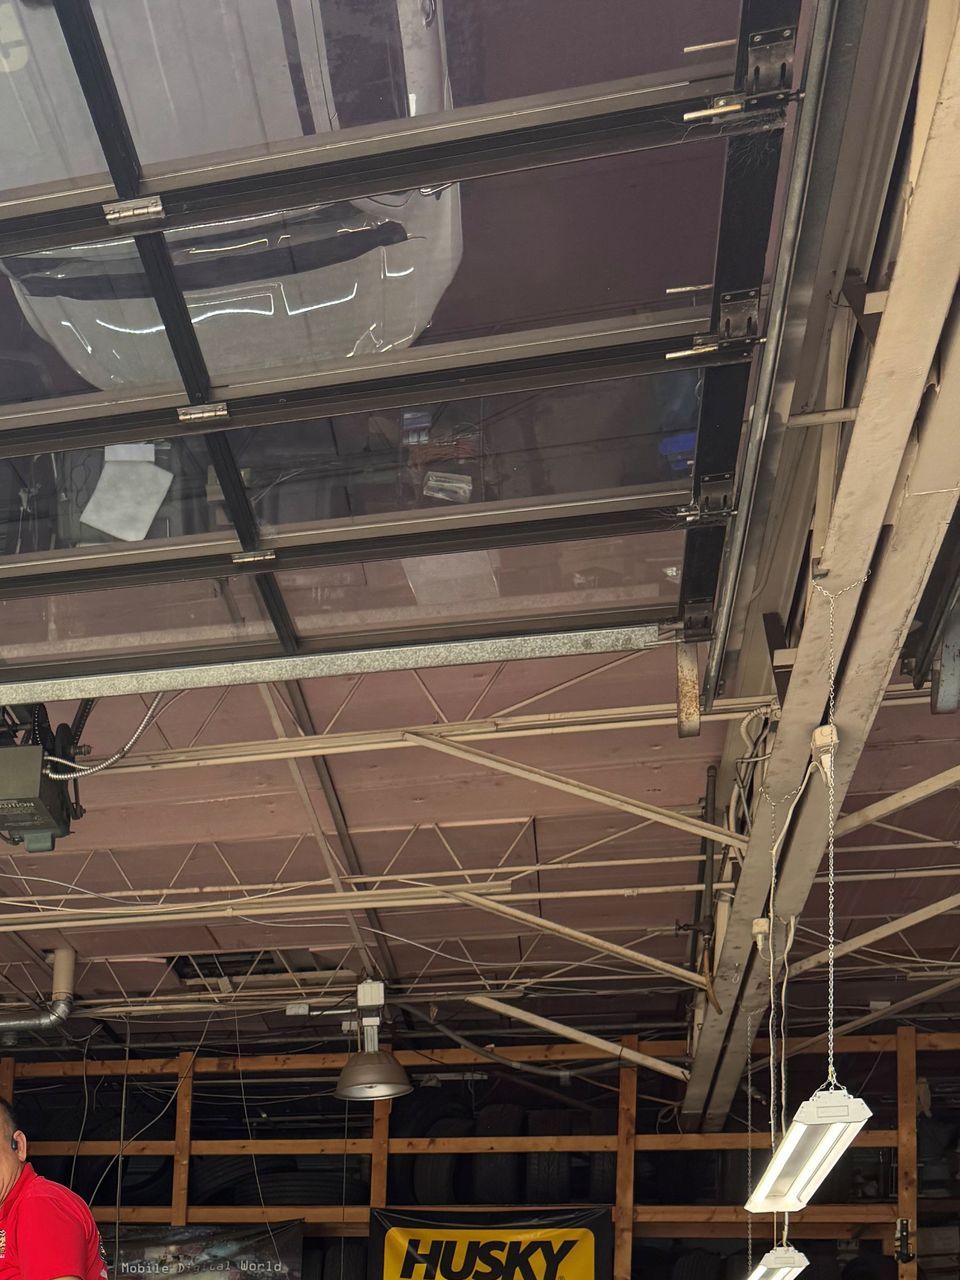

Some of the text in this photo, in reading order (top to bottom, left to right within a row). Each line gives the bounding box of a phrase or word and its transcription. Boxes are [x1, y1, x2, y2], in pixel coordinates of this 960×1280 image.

[121, 1261, 283, 1274] Mobile Digital World
